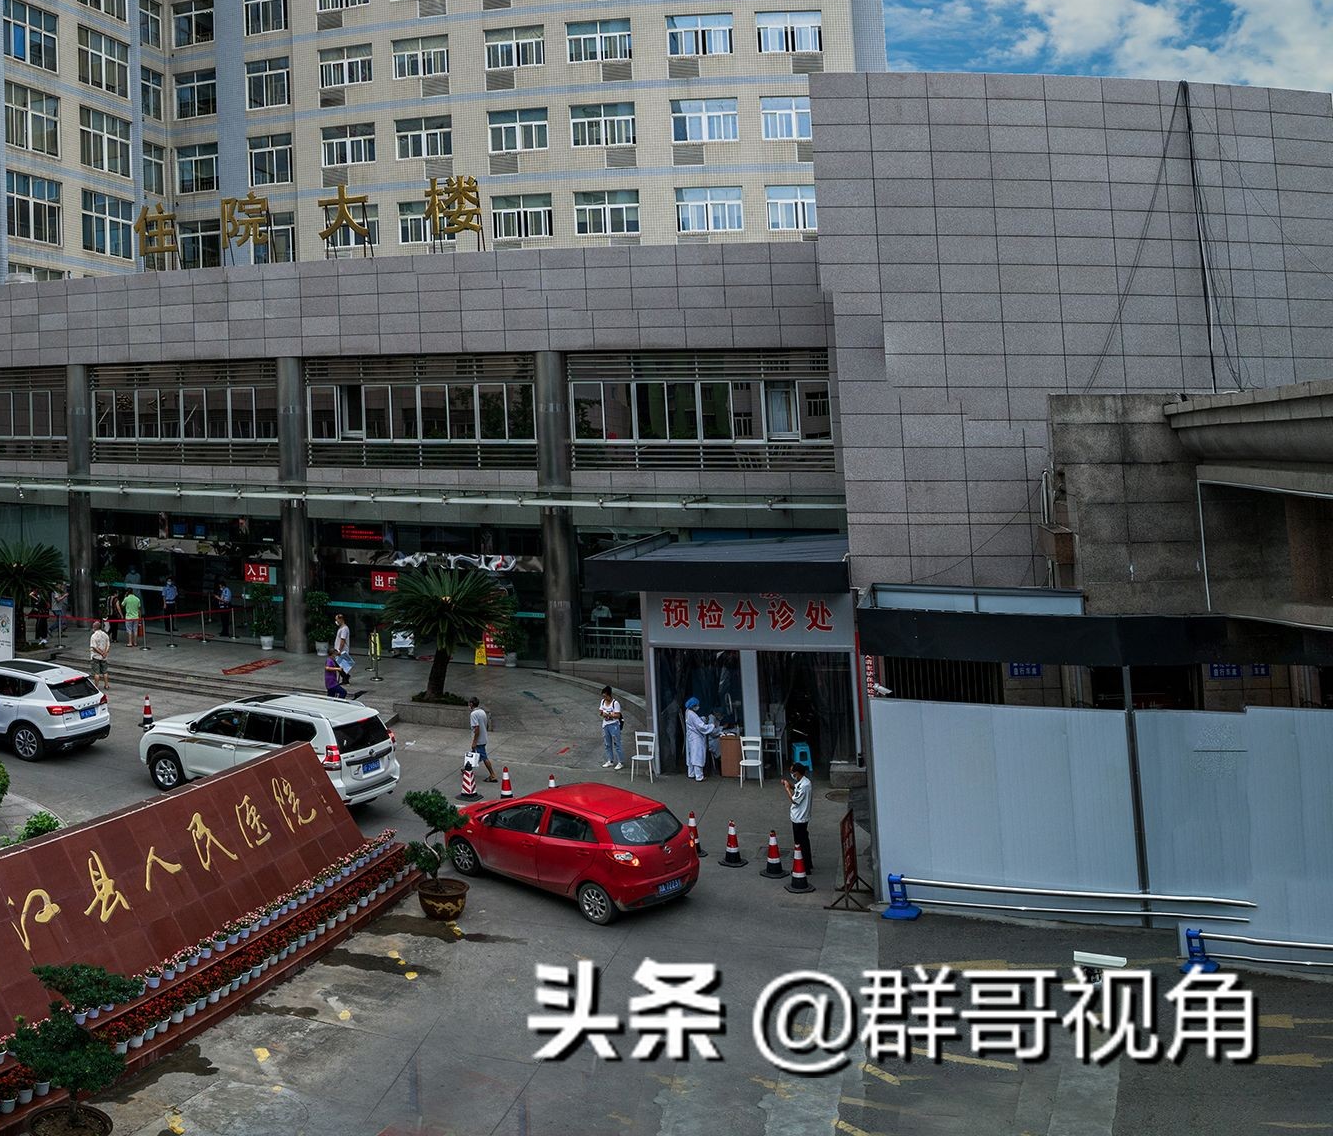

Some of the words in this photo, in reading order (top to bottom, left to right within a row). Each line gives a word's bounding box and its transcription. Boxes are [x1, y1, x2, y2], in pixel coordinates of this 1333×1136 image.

[134, 175, 481, 257] 住院大楼
[247, 565, 268, 577] 入口
[661, 597, 834, 633] 预检分诊处
